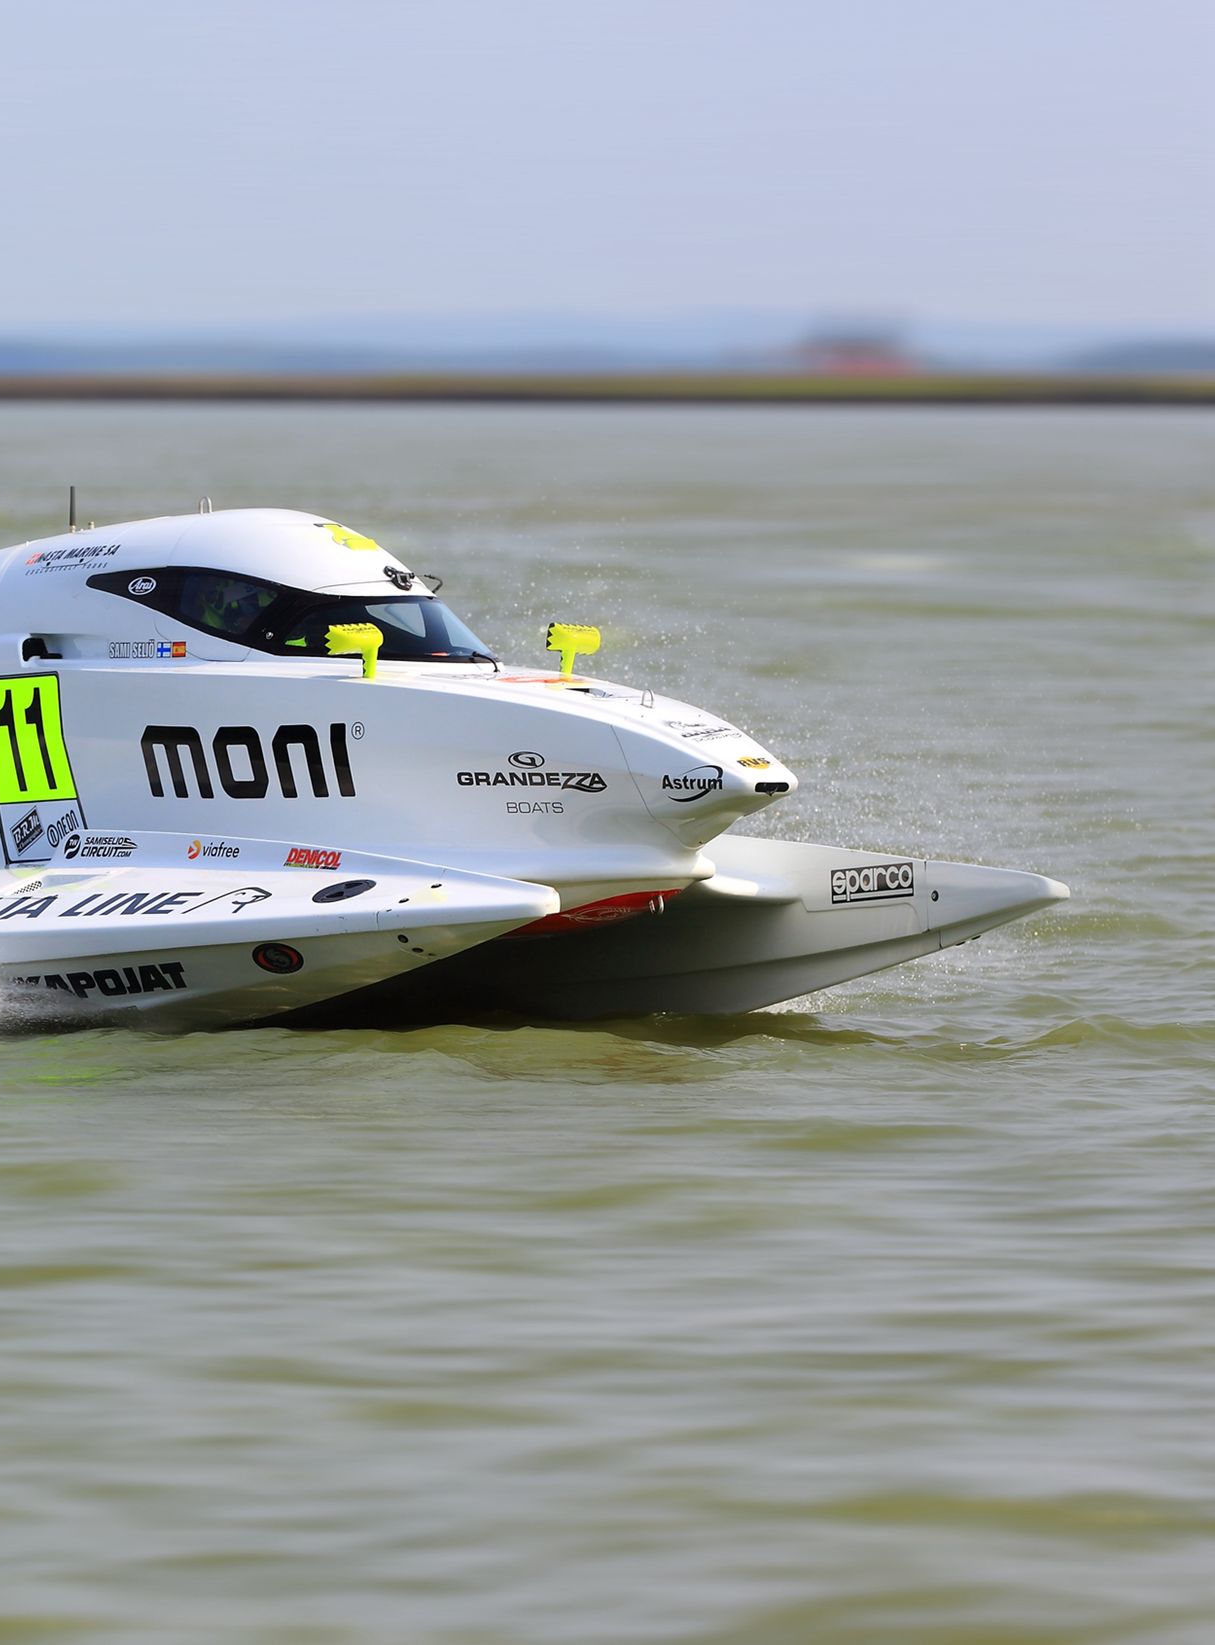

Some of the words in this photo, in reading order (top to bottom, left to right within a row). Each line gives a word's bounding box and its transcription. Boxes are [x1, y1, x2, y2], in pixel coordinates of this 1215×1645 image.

[64, 544, 107, 559] MARINE
[103, 544, 121, 557] SA
[109, 641, 131, 658] SAMI
[456, 771, 608, 793] GRANDEZZA
[662, 774, 723, 790] Astrum
[506, 801, 564, 814] BOATS
[84, 836, 124, 846] SAMISELIO
[202, 842, 240, 858] viafree
[832, 864, 913, 902] sparco
[57, 890, 206, 918] LINE
[12, 961, 188, 999] APOJAT
